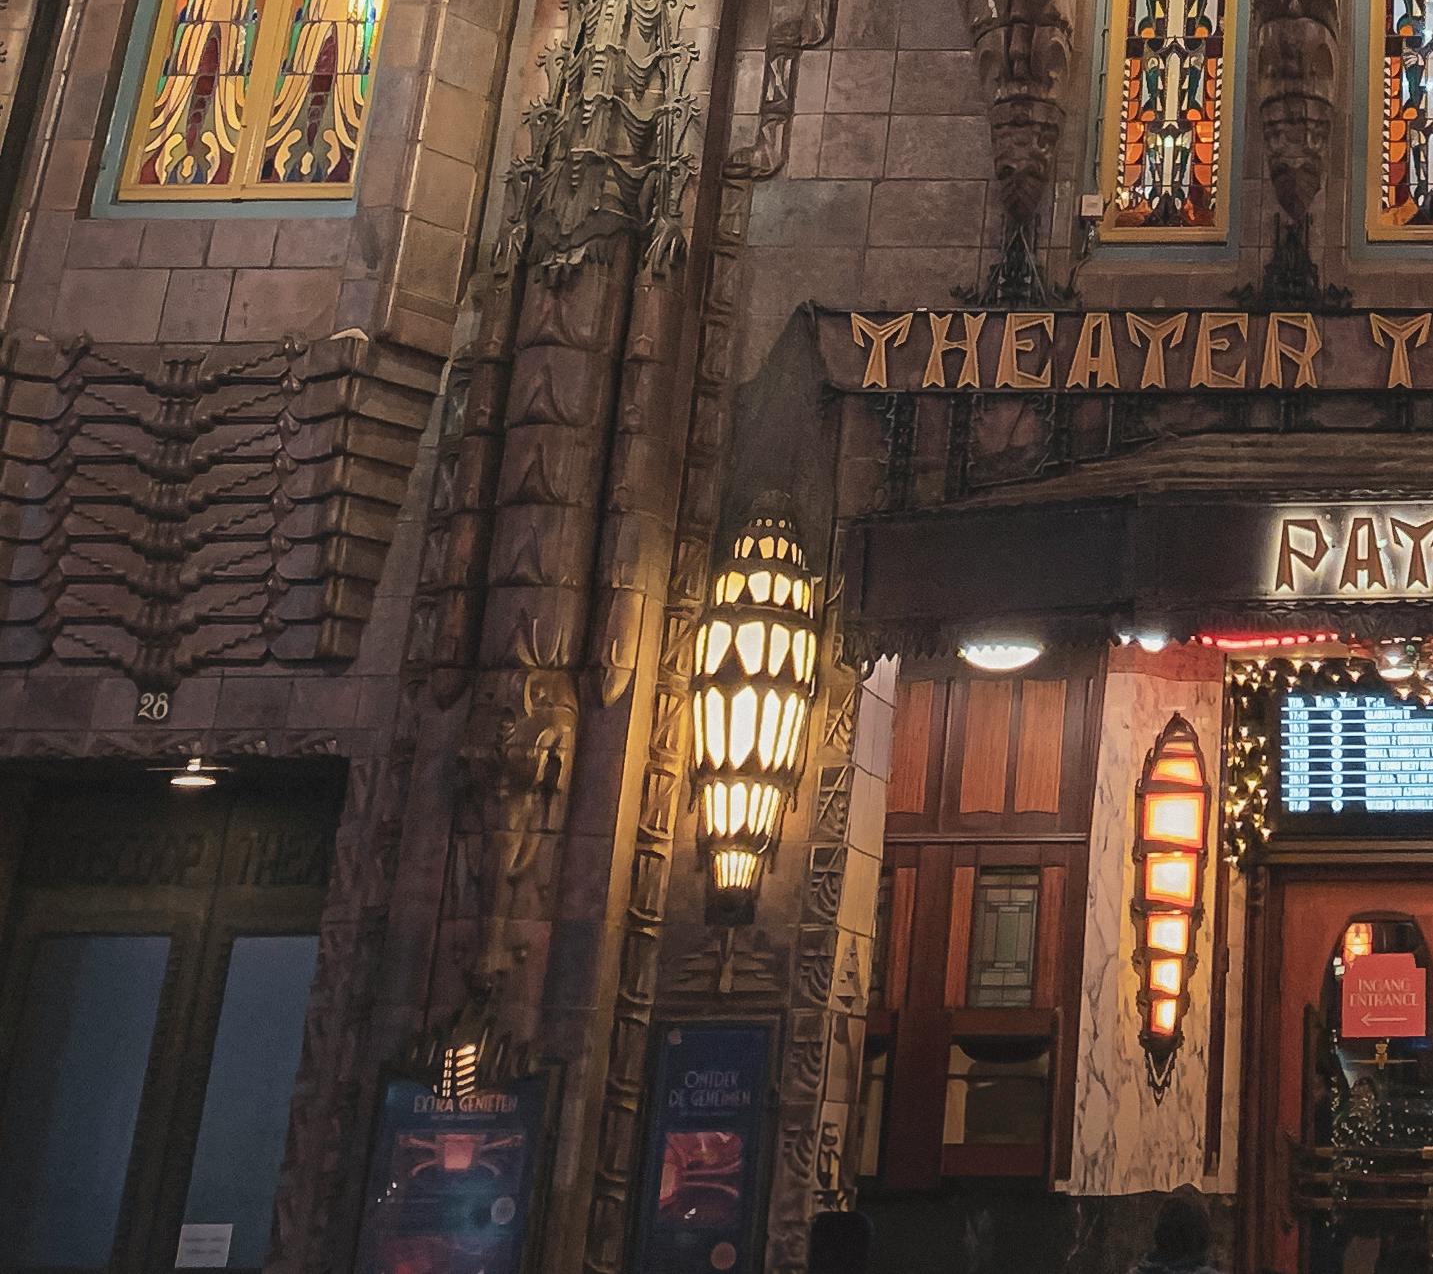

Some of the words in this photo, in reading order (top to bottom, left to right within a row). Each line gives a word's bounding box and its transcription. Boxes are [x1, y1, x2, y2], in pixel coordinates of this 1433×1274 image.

[851, 312, 1322, 389] THEATER
[138, 692, 168, 720] 28
[1358, 978, 1409, 992] INGANG
[1350, 993, 1419, 1007] ENTRANCE
